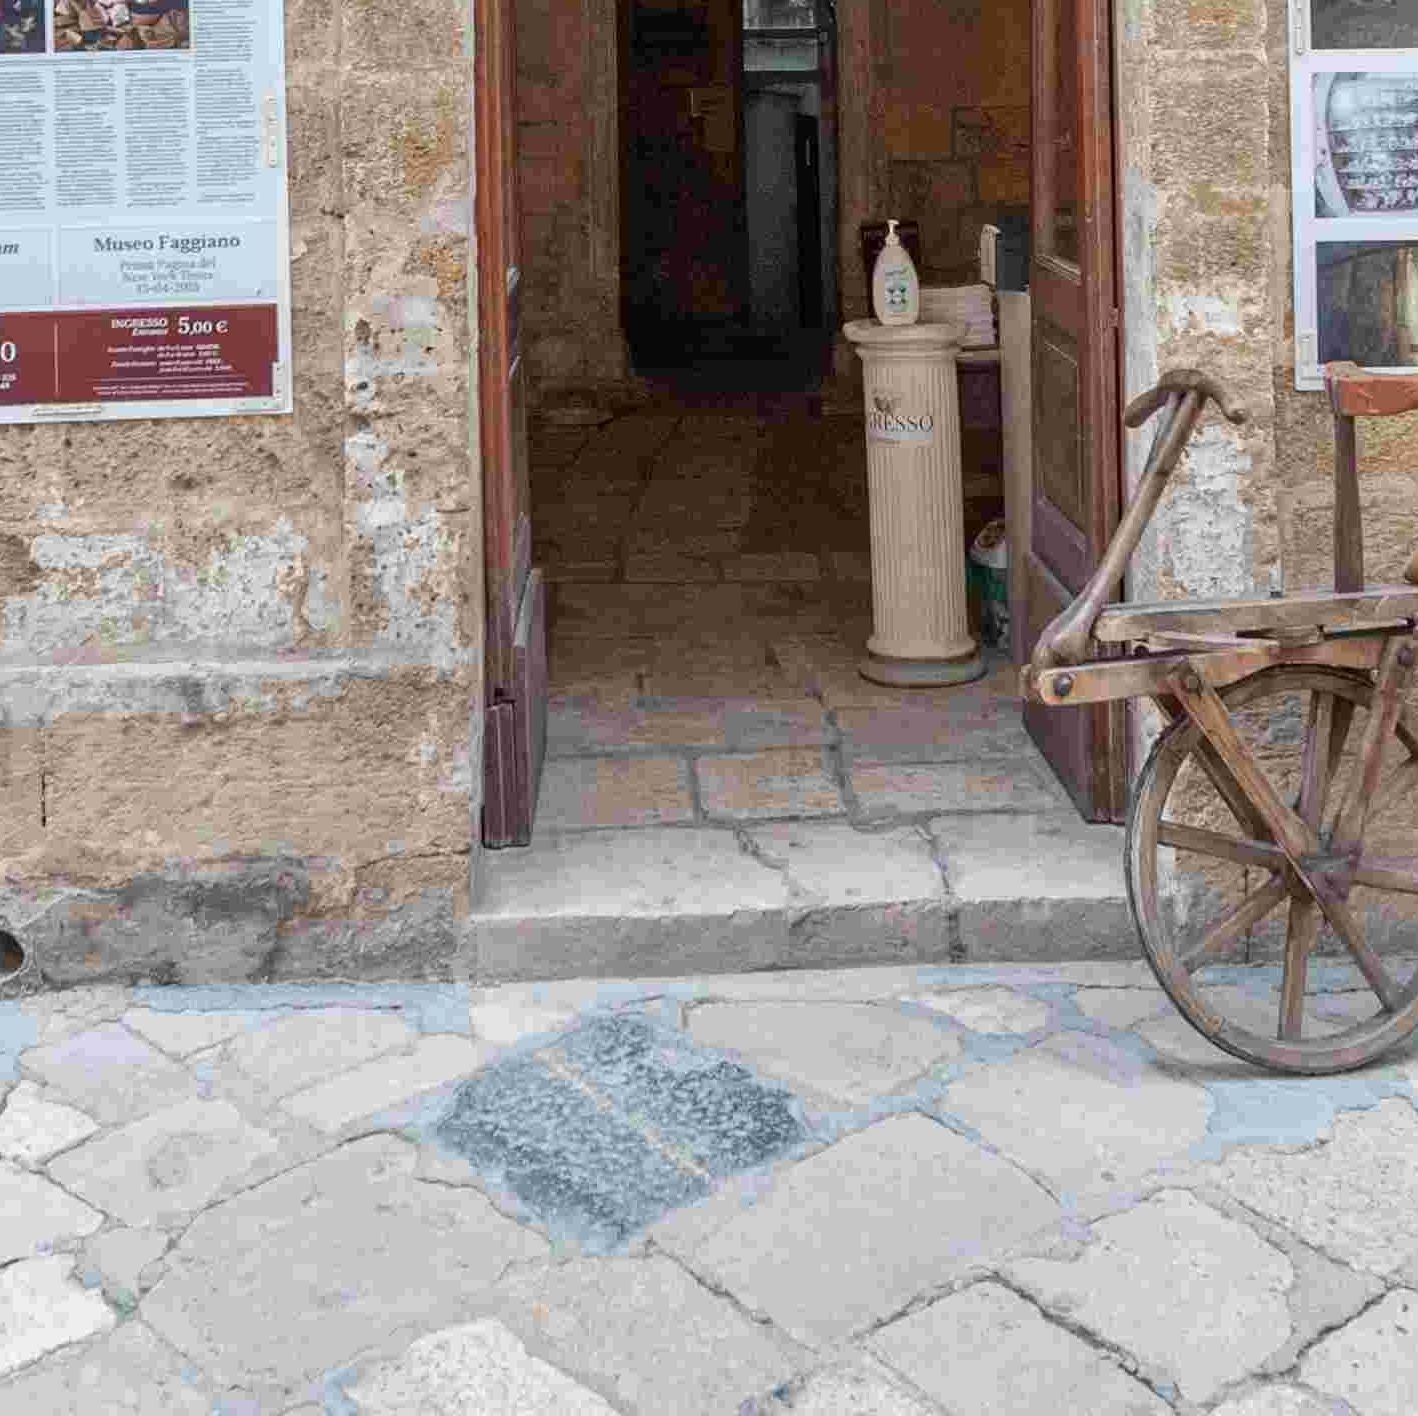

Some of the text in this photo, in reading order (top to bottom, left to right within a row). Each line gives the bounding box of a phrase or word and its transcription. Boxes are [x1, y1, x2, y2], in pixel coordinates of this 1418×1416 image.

[93, 235, 240, 254] Museo Faggiano
[178, 316, 213, 335] 5,00
[215, 319, 229, 334] €
